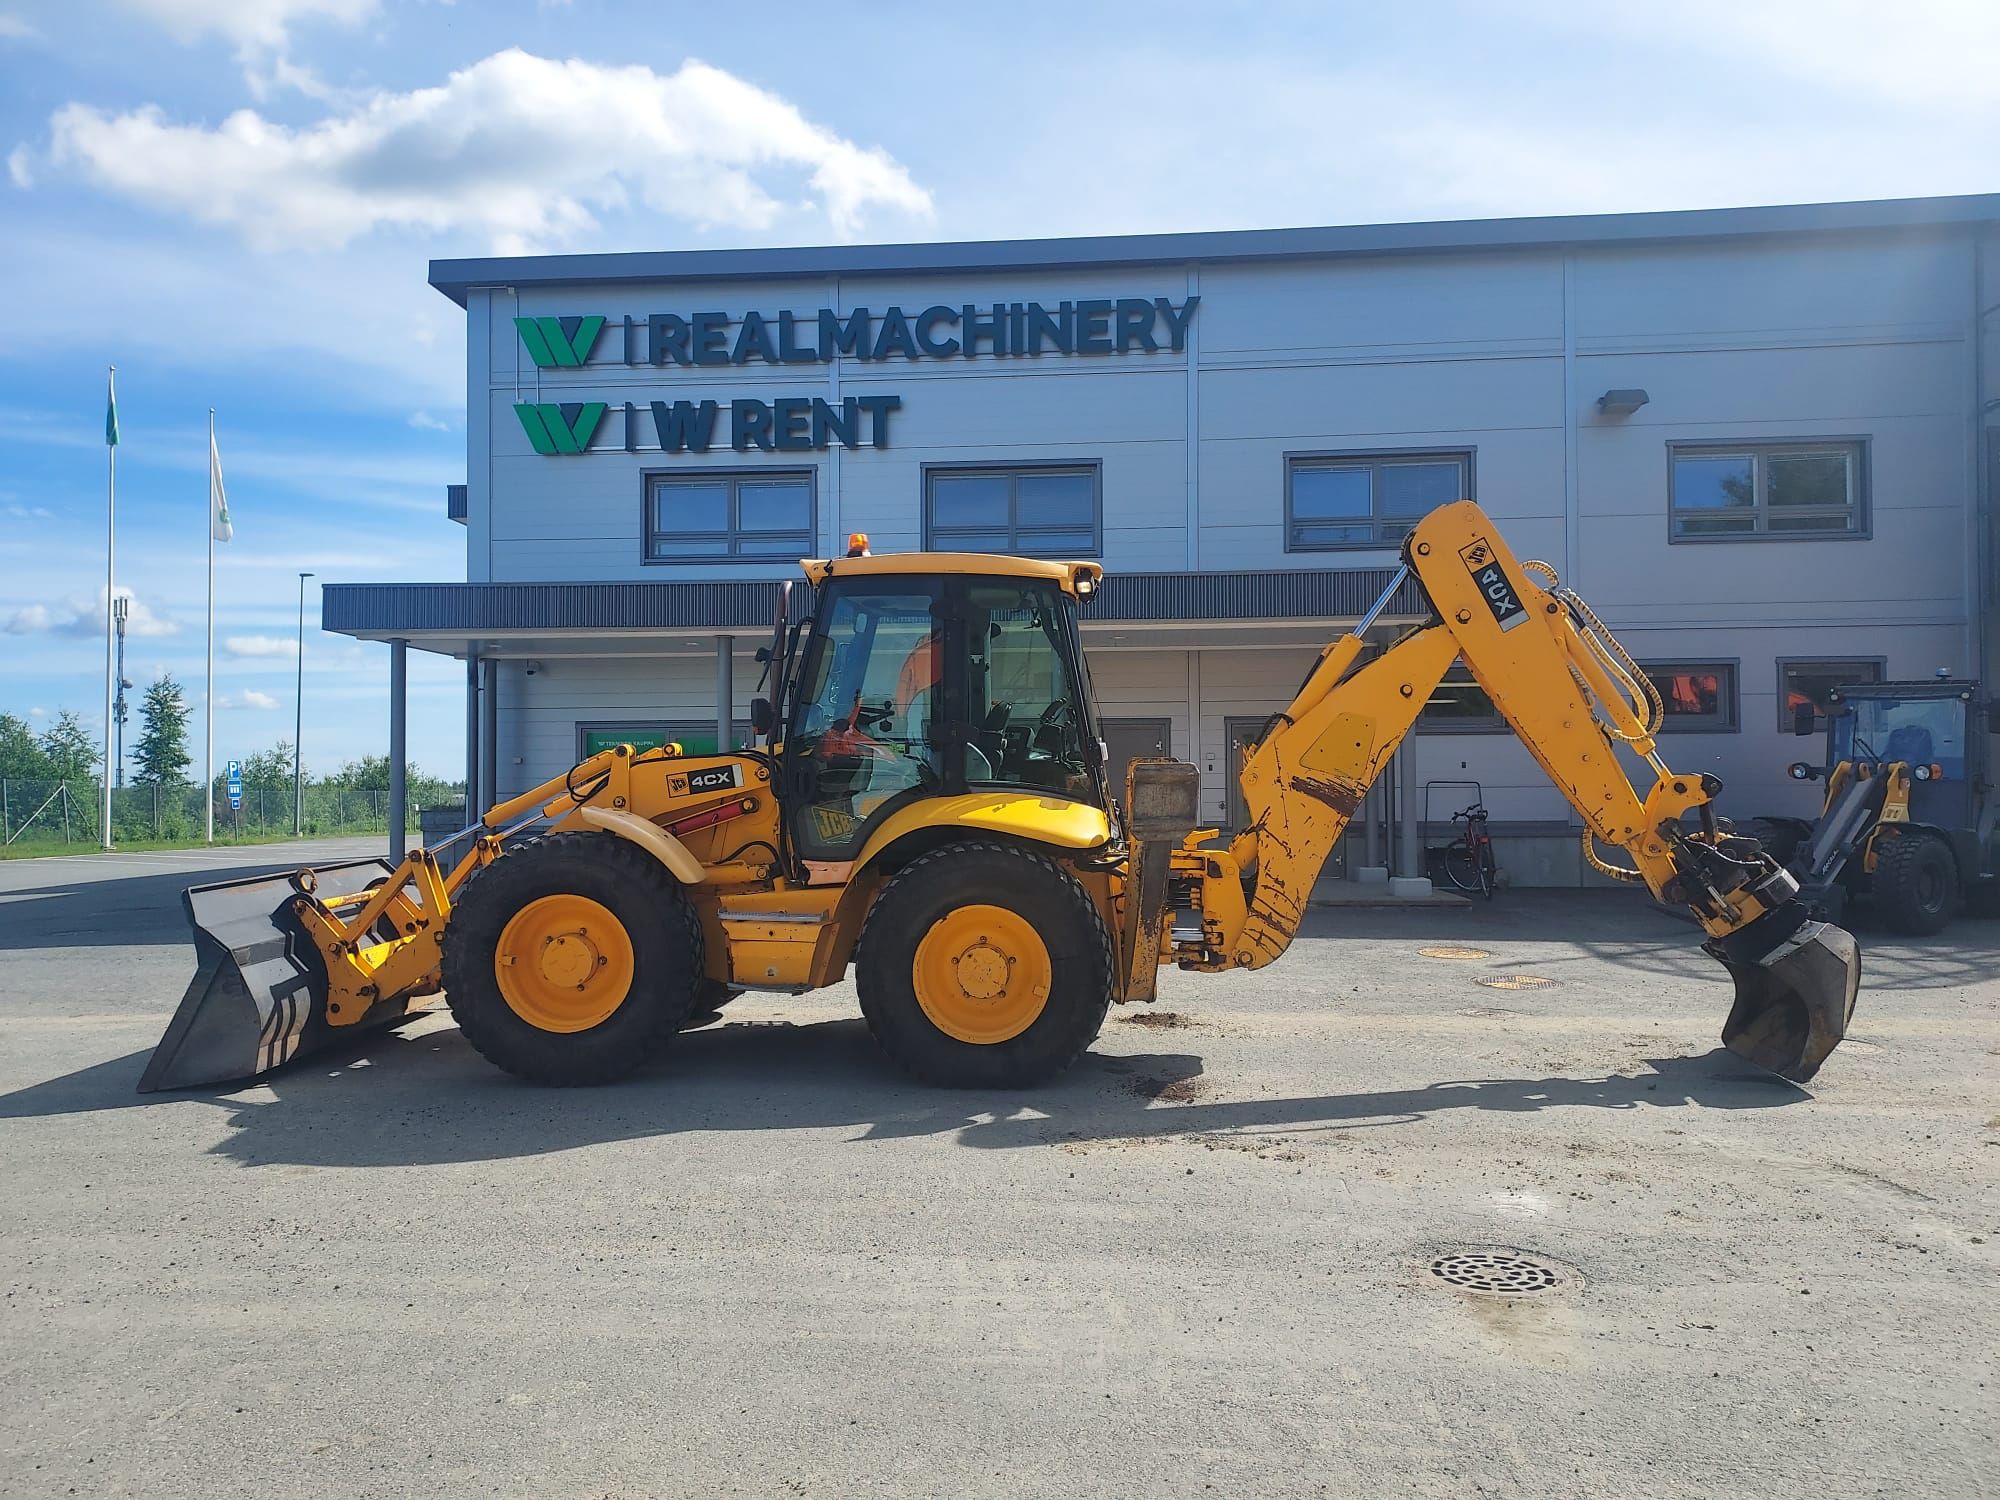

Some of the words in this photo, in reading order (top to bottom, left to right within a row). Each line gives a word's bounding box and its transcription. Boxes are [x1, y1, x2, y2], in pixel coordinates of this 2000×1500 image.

[648, 296, 1201, 366] REALMACHINERY
[650, 399, 718, 453] W
[731, 395, 901, 452] RENT
[1468, 545, 1486, 564] JCB
[1481, 569, 1517, 616] 4CX
[229, 761, 238, 778] P
[691, 772, 731, 787] 4CX
[819, 811, 852, 838] JCB
